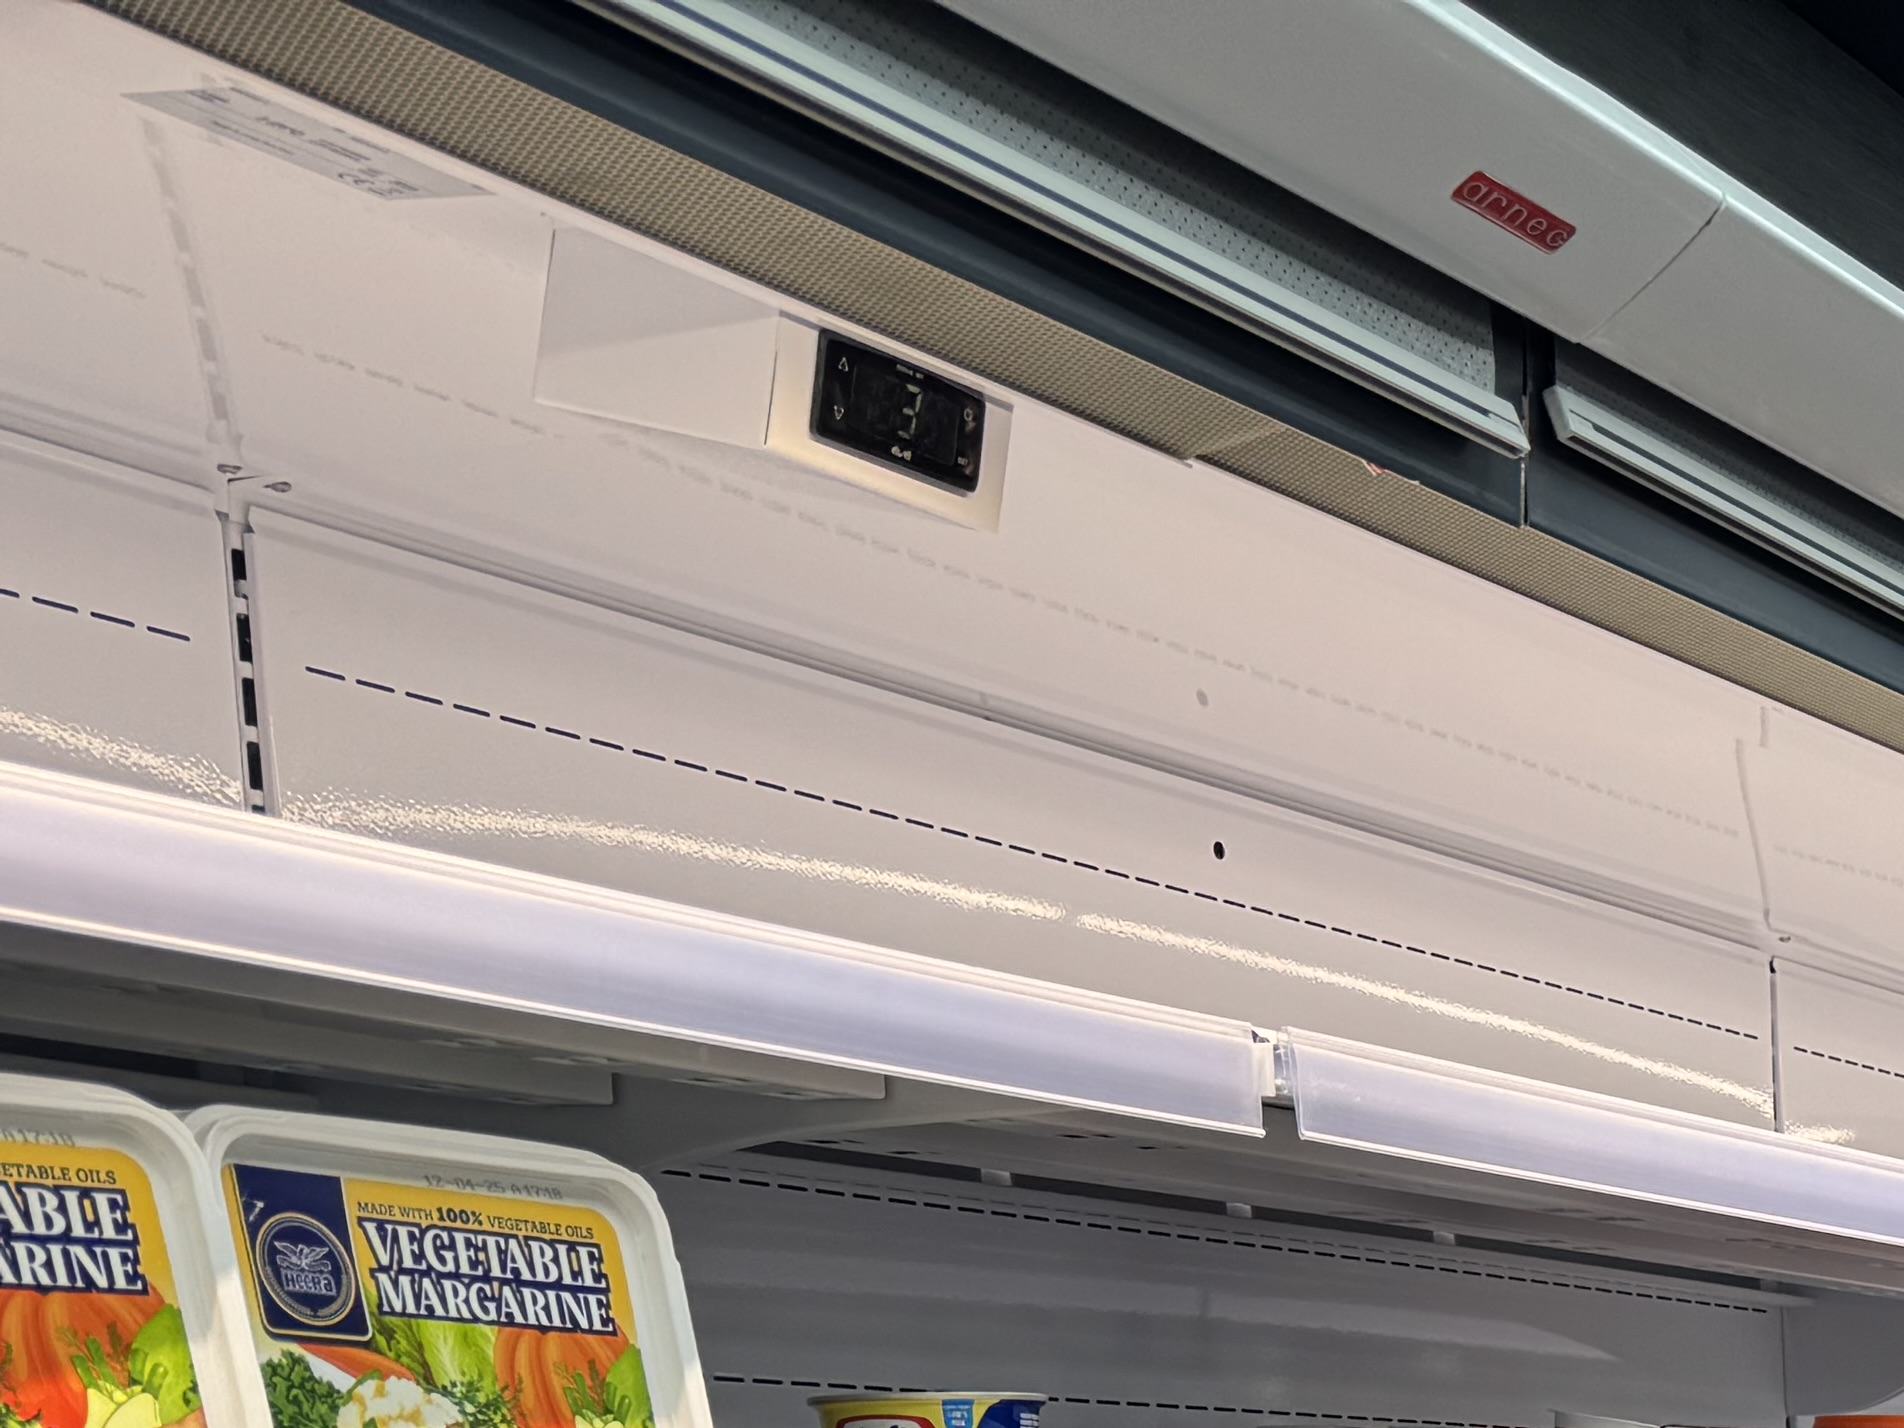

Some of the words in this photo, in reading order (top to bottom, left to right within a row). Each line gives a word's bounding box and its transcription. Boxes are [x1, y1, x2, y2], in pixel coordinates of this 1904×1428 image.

[76, 1169, 117, 1185] OILS
[357, 1202, 396, 1217] MADE
[399, 1207, 434, 1221] WITH
[436, 1208, 483, 1227] 100%
[487, 1216, 562, 1235] VEGETABLE
[566, 1226, 594, 1240] OILS
[360, 1221, 607, 1289] VEGETABLE
[374, 1271, 613, 1332] MARGARINE
